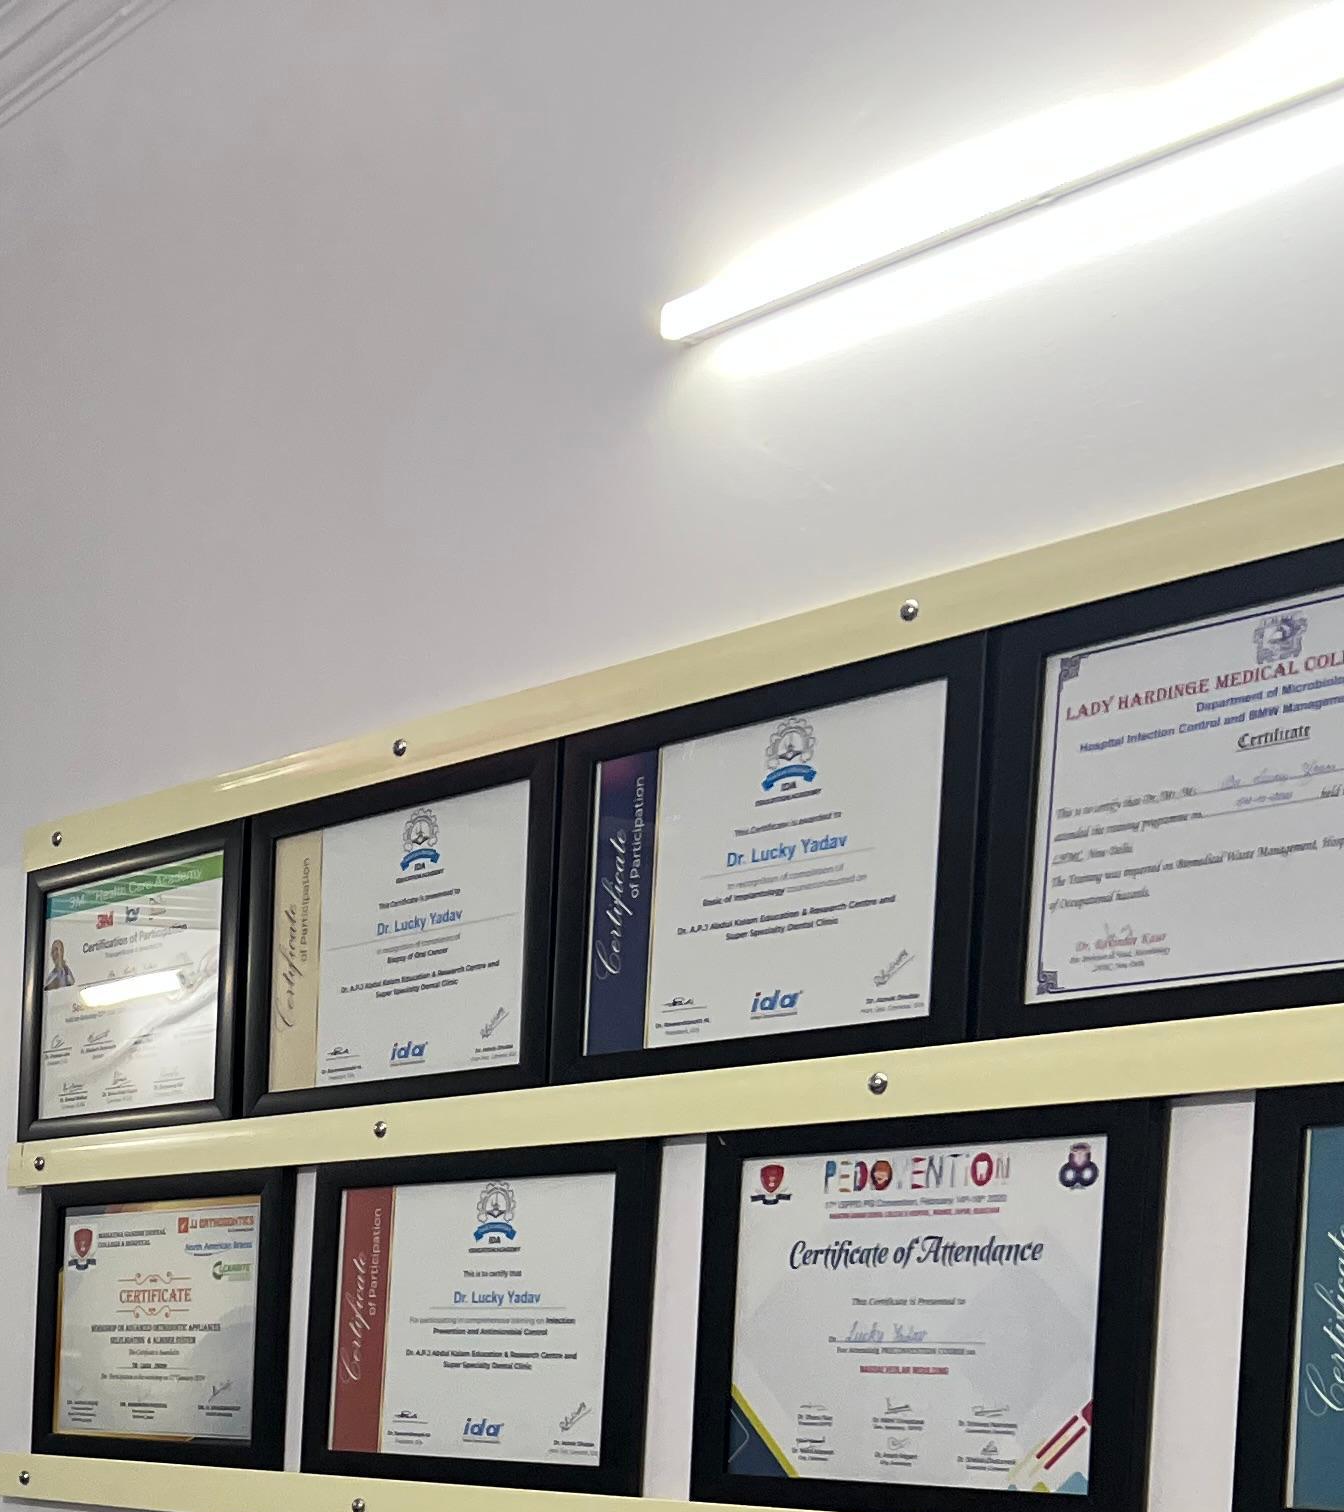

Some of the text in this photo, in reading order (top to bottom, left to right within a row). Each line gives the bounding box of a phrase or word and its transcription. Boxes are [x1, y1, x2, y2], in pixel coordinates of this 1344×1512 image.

[1065, 651, 1344, 721] LADY HARDINGE MEDICAL COL
[1267, 686, 1279, 699] of
[1079, 737, 1124, 753] Hospital
[1126, 726, 1175, 744] Infection
[1178, 716, 1221, 733] Control
[1224, 712, 1246, 726] and
[1248, 706, 1279, 722] BMW
[1237, 725, 1311, 749] Certificate
[629, 776, 645, 880] Participation
[727, 833, 848, 867] Dr. Lucky Yadav
[394, 914, 426, 933] Lucky
[430, 909, 463, 925] Yadav
[751, 989, 800, 1013] ida
[390, 1040, 428, 1061] ida
[368, 1208, 383, 1298] Participation
[789, 1235, 1044, 1271] Certificate of Attendance
[119, 1287, 192, 1304] CERTIFICATE
[454, 1291, 541, 1306] Dr. Lucky Yadav
[463, 1417, 502, 1437] ida
